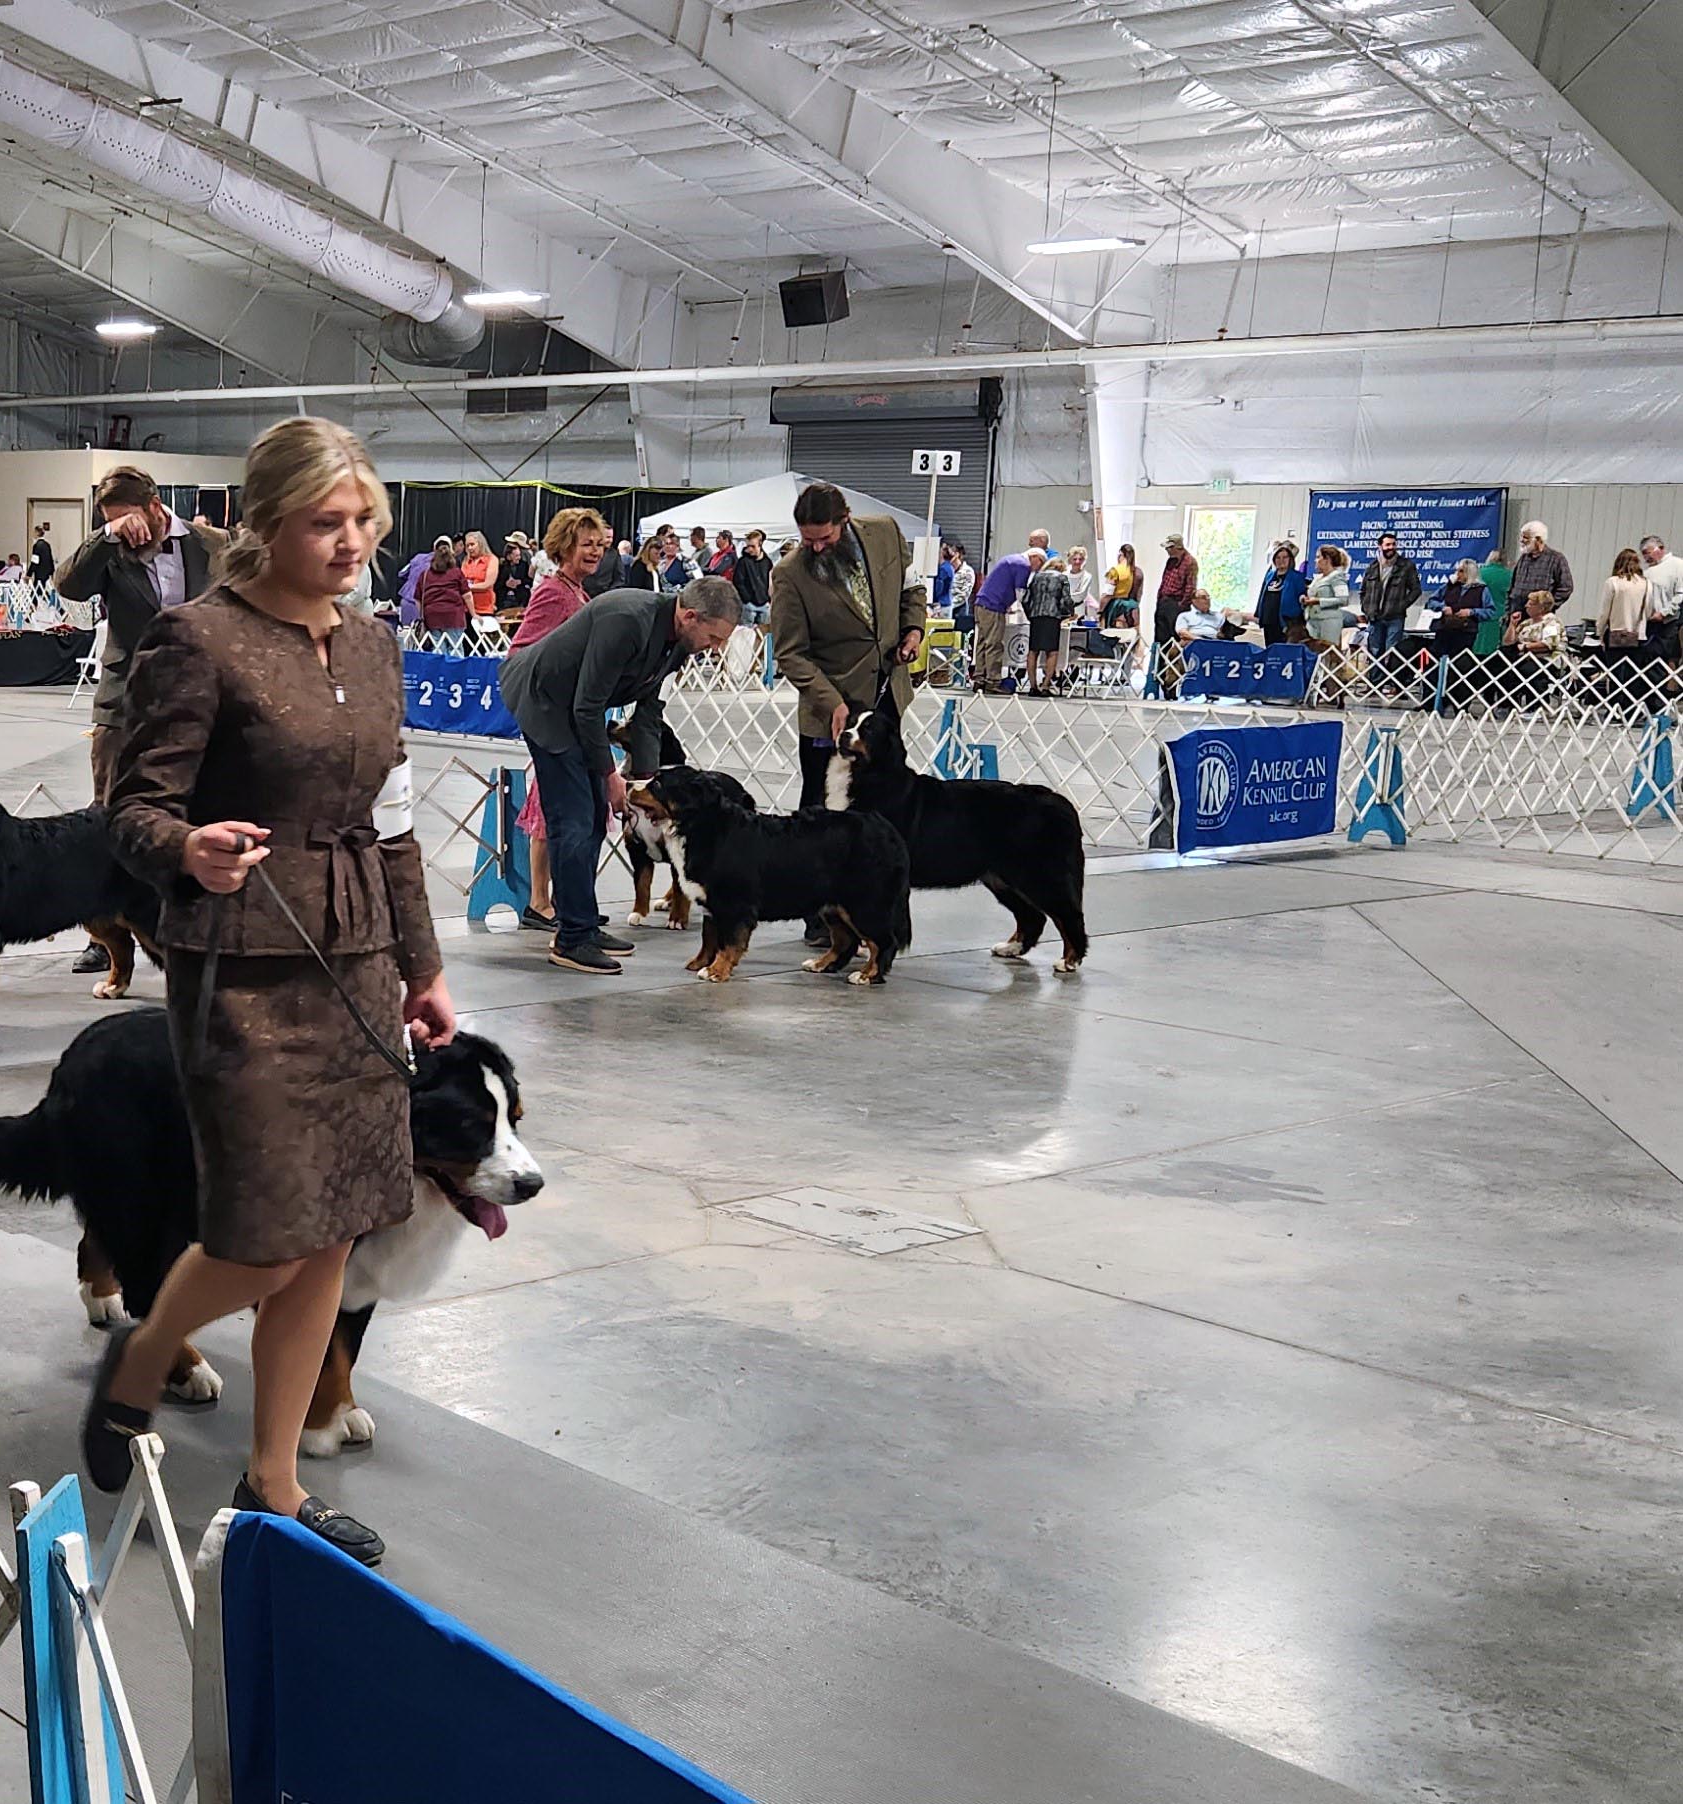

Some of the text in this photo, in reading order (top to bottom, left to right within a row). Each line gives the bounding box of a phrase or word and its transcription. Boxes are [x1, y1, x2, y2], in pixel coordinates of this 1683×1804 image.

[919, 454, 953, 471] 3 3
[1317, 498, 1330, 509] Do
[1331, 500, 1347, 511] you
[1359, 500, 1380, 511] your
[1382, 497, 1415, 508] animals
[1417, 497, 1438, 507] have
[1439, 497, 1465, 507] issues
[1361, 520, 1444, 529] PACING SIDEWINDING
[1396, 530, 1426, 539] MOTION
[1344, 540, 1379, 548] LAMENES
[1420, 540, 1460, 548] SORENESS
[1405, 550, 1416, 558] TO
[1202, 660, 1211, 677] 1
[1227, 660, 1241, 678] 2
[1253, 662, 1265, 679] 3
[1281, 662, 1294, 679] 4
[418, 681, 433, 706] 2
[448, 683, 463, 709] 3
[480, 685, 492, 710] 4
[1245, 756, 1326, 783] AMERICAN
[1242, 786, 1289, 806] KENNEL
